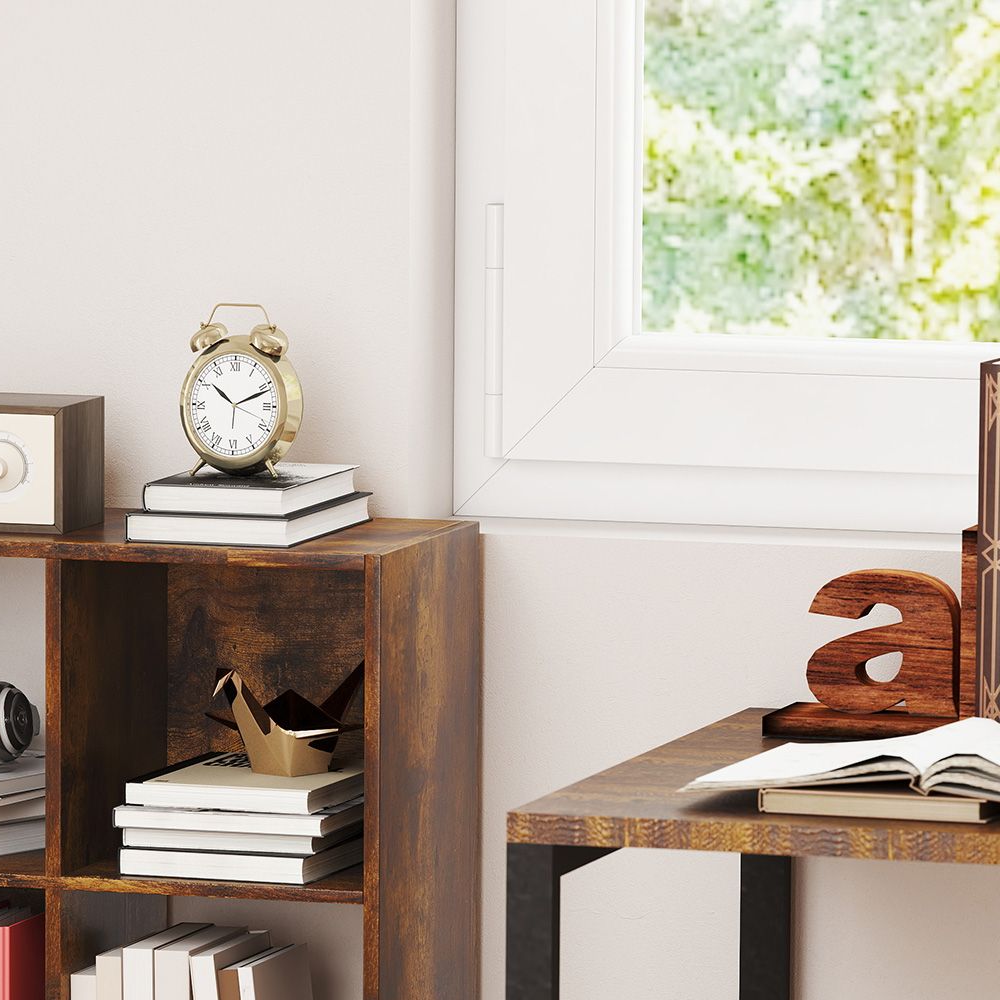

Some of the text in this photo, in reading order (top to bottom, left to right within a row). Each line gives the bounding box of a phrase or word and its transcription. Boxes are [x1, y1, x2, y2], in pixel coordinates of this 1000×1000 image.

[229, 362, 241, 372] XII
[262, 402, 271, 411] III
[806, 568, 961, 719] a
